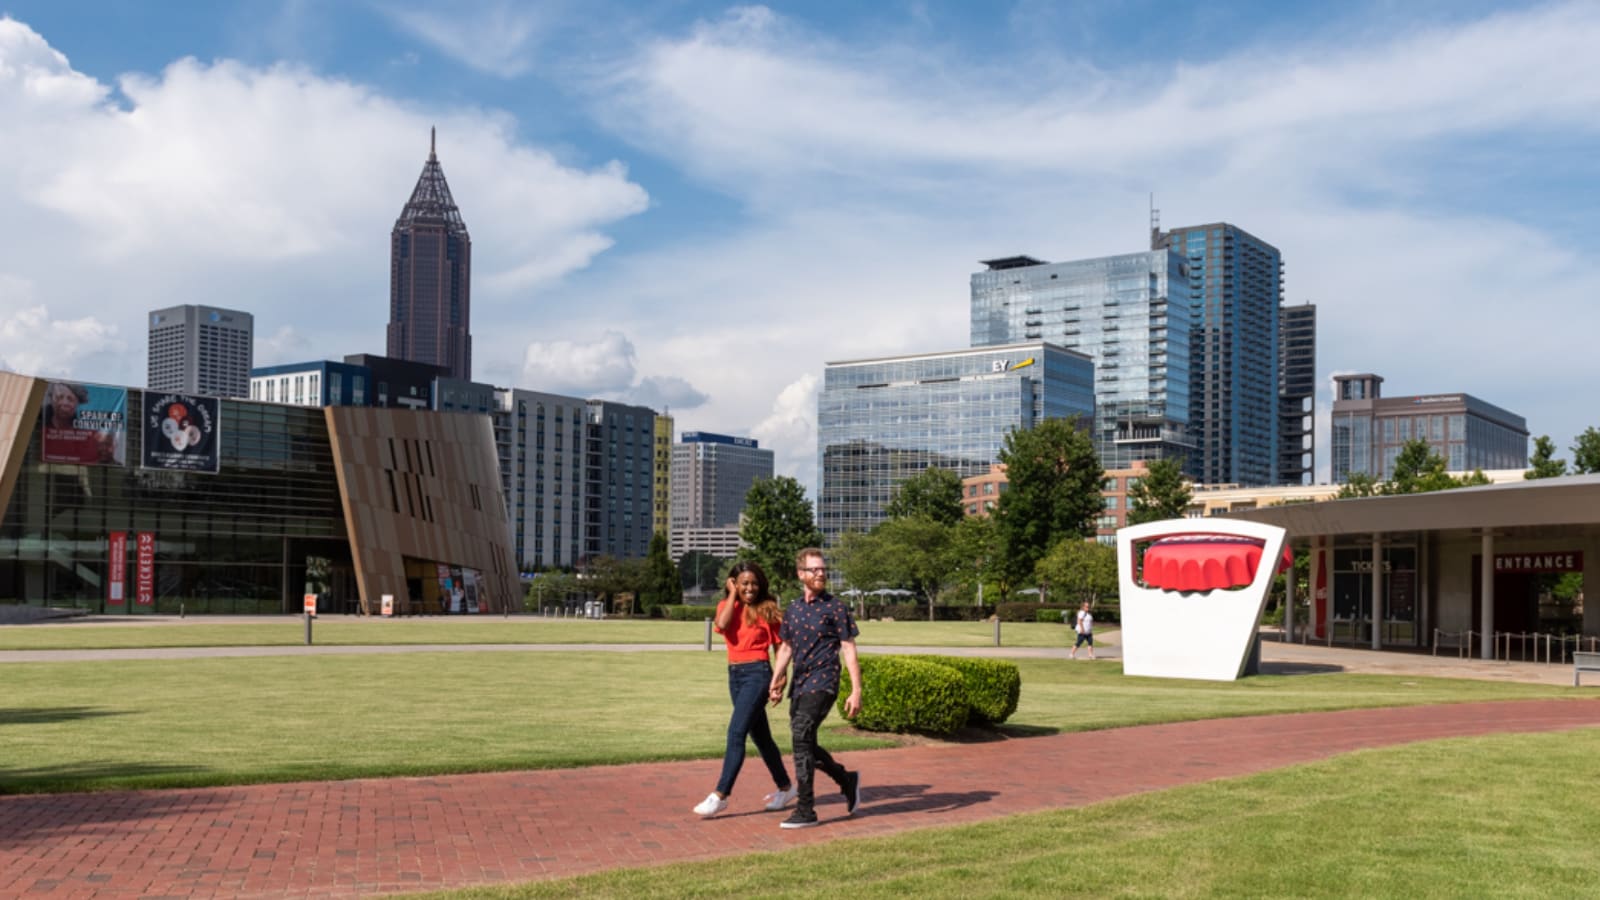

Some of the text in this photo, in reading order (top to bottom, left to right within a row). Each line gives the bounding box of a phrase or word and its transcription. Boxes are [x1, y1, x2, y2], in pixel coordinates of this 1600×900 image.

[993, 360, 1008, 371] EY
[80, 410, 107, 420] SPARK
[72, 419, 124, 430] CONVICTION
[1496, 555, 1574, 569] ENTRANCE
[140, 545, 152, 592] TICKETS
